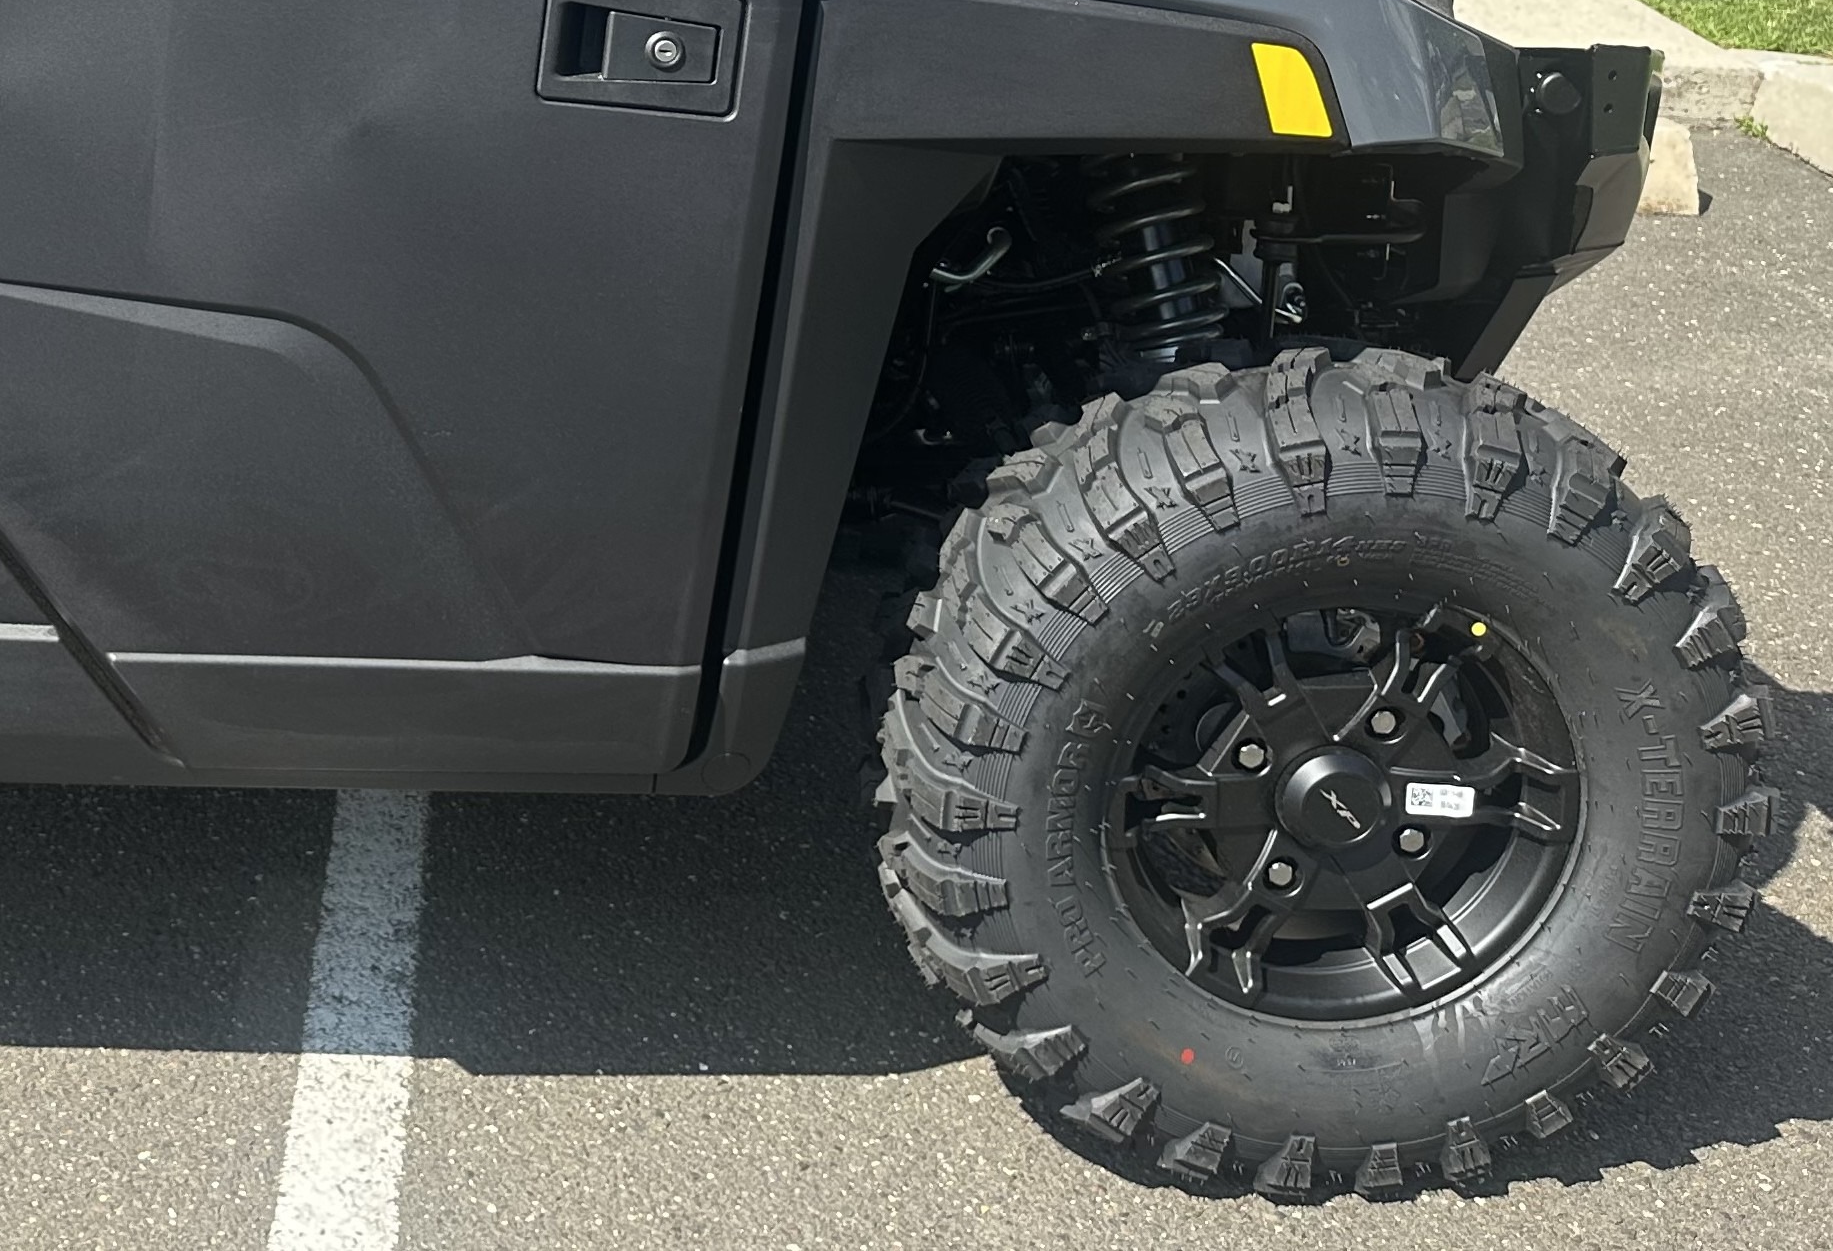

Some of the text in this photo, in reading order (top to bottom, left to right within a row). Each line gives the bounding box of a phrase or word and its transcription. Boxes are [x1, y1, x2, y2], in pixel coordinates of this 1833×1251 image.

[1044, 740, 1108, 979] PRO ARMOR
[1319, 789, 1362, 830] XP
[1603, 678, 1685, 953] X-TERRAIN
